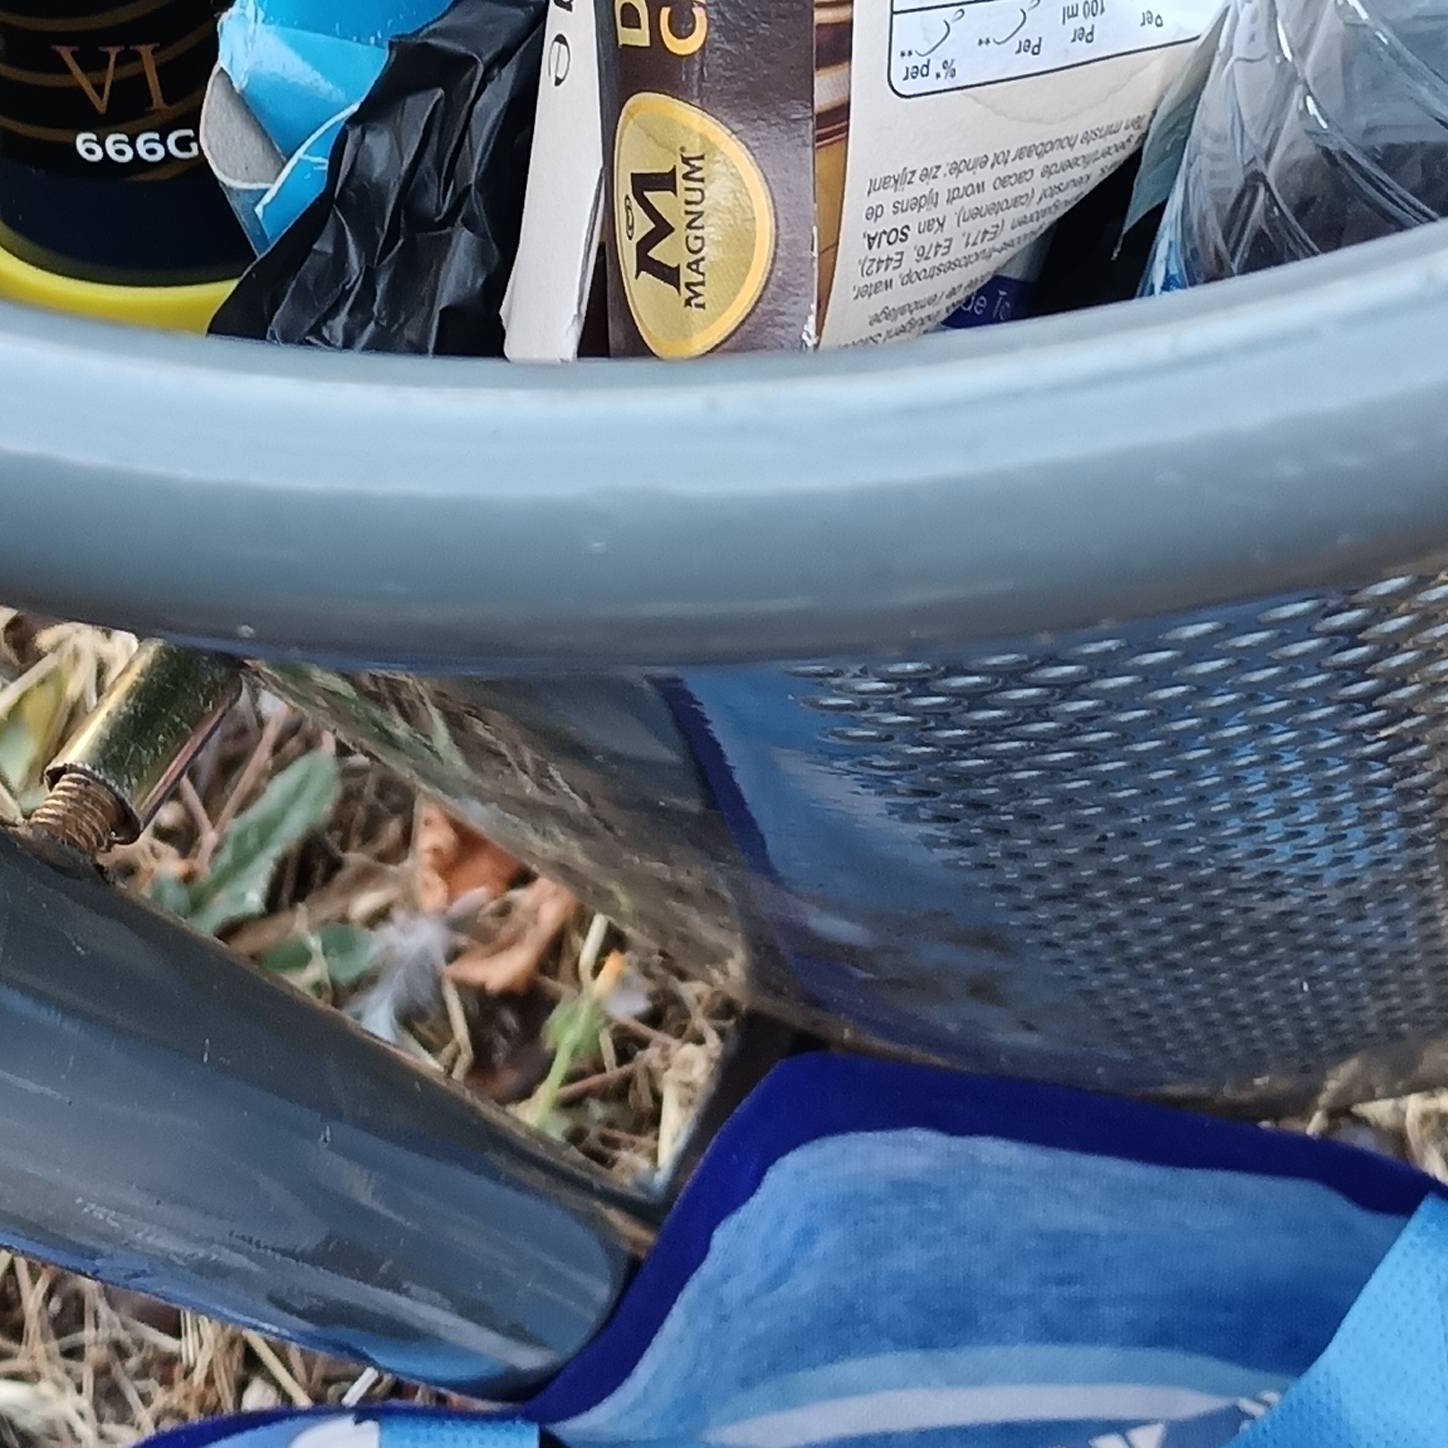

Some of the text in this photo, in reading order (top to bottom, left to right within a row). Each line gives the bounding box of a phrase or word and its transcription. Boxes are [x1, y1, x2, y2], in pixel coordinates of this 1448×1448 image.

[1062, 3, 1080, 26] ml
[1069, 23, 1095, 44] Per
[1015, 35, 1043, 56] Per
[902, 59, 931, 82] per
[74, 129, 200, 164] 666G
[864, 204, 885, 222] de
[631, 162, 684, 292] M
[682, 157, 707, 312] MAGNUM
[916, 214, 947, 236] Kan
[862, 223, 912, 251] SOJA,
